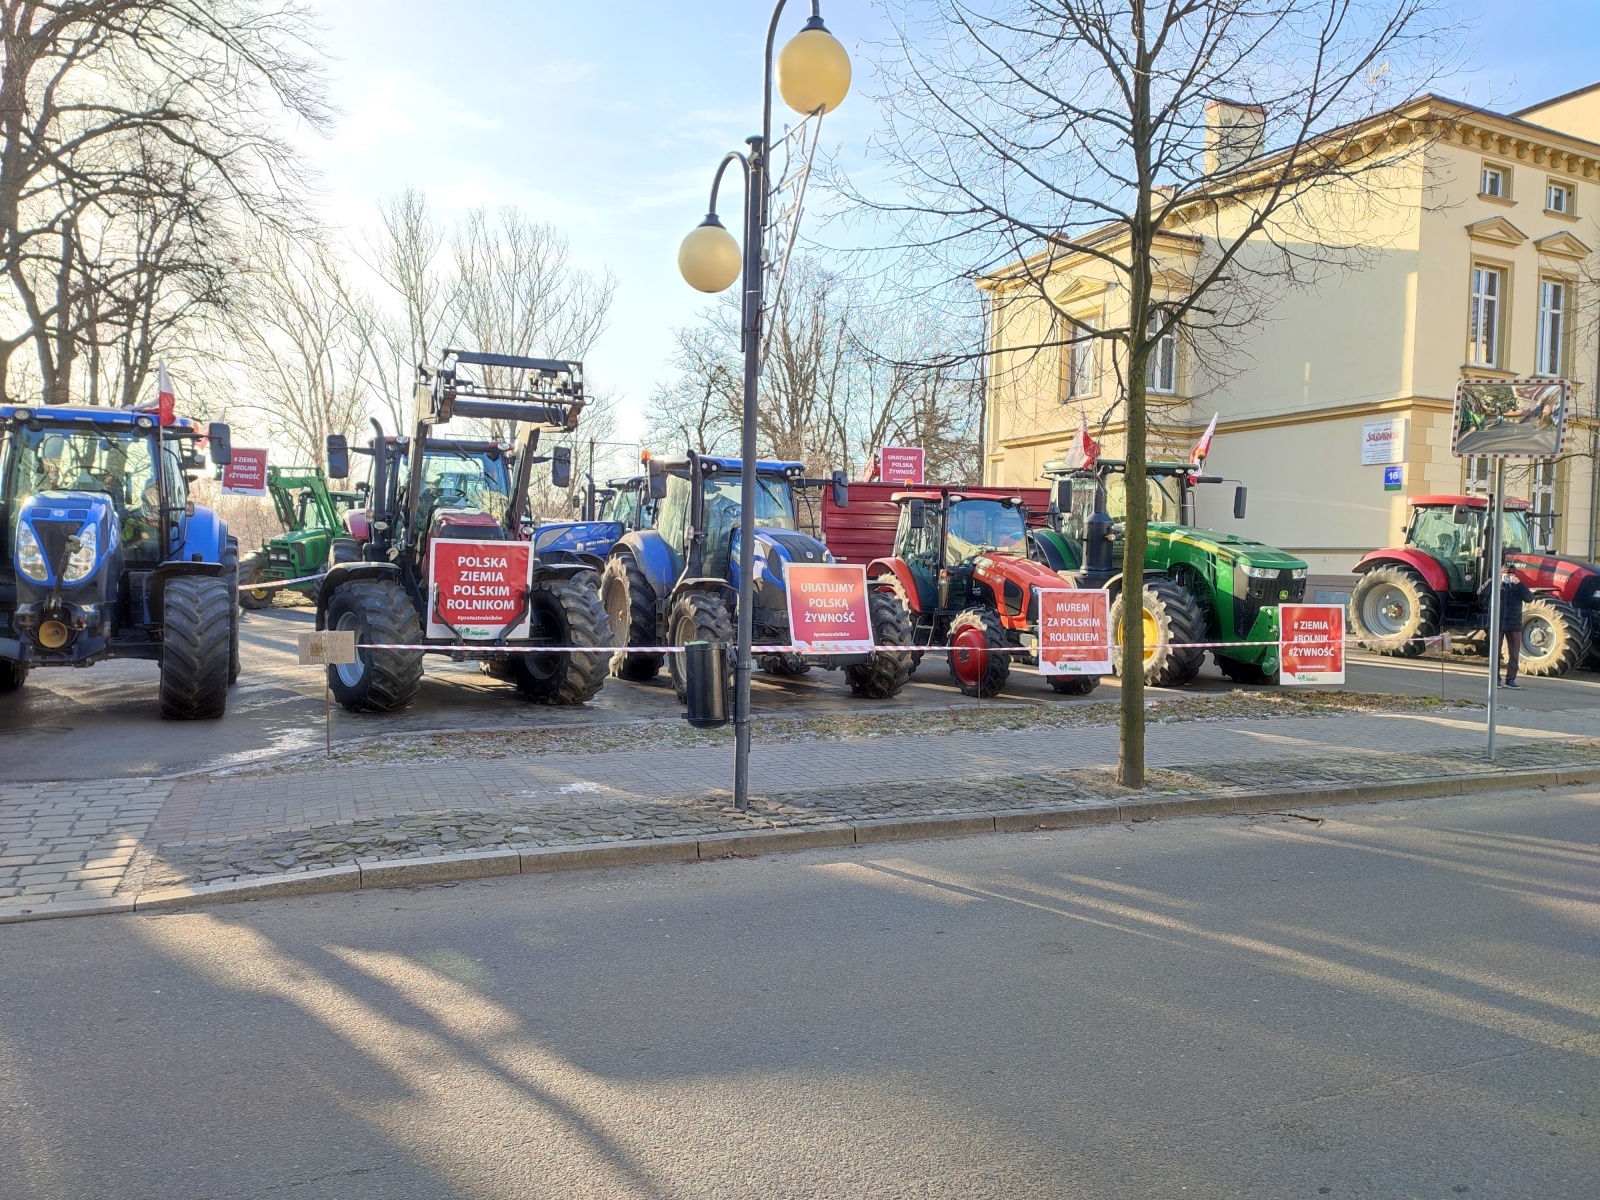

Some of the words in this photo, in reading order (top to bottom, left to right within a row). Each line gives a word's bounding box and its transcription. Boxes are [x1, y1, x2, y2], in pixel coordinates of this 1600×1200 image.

[228, 471, 260, 480] #ŻYWNOŚĆ
[1387, 471, 1399, 481] 16
[457, 556, 508, 568] POLSKA
[459, 570, 505, 582] ZIEMIA
[453, 584, 510, 596] POLSKIM
[800, 582, 855, 593] URATUJMY
[446, 598, 515, 610] ROLNIKOM
[808, 597, 850, 611] POLSKĄ
[1056, 602, 1090, 613] MUREM
[804, 611, 856, 623] ŻYWNOŚĆ
[1047, 617, 1059, 627] ZA
[1060, 617, 1101, 627] POLSKIM
[1293, 621, 1299, 630] #
[1299, 621, 1329, 630] ZIEMIA
[1049, 632, 1099, 642] ROLNIKIEM
[1288, 645, 1335, 657] #ŻYWNOŚĆ
